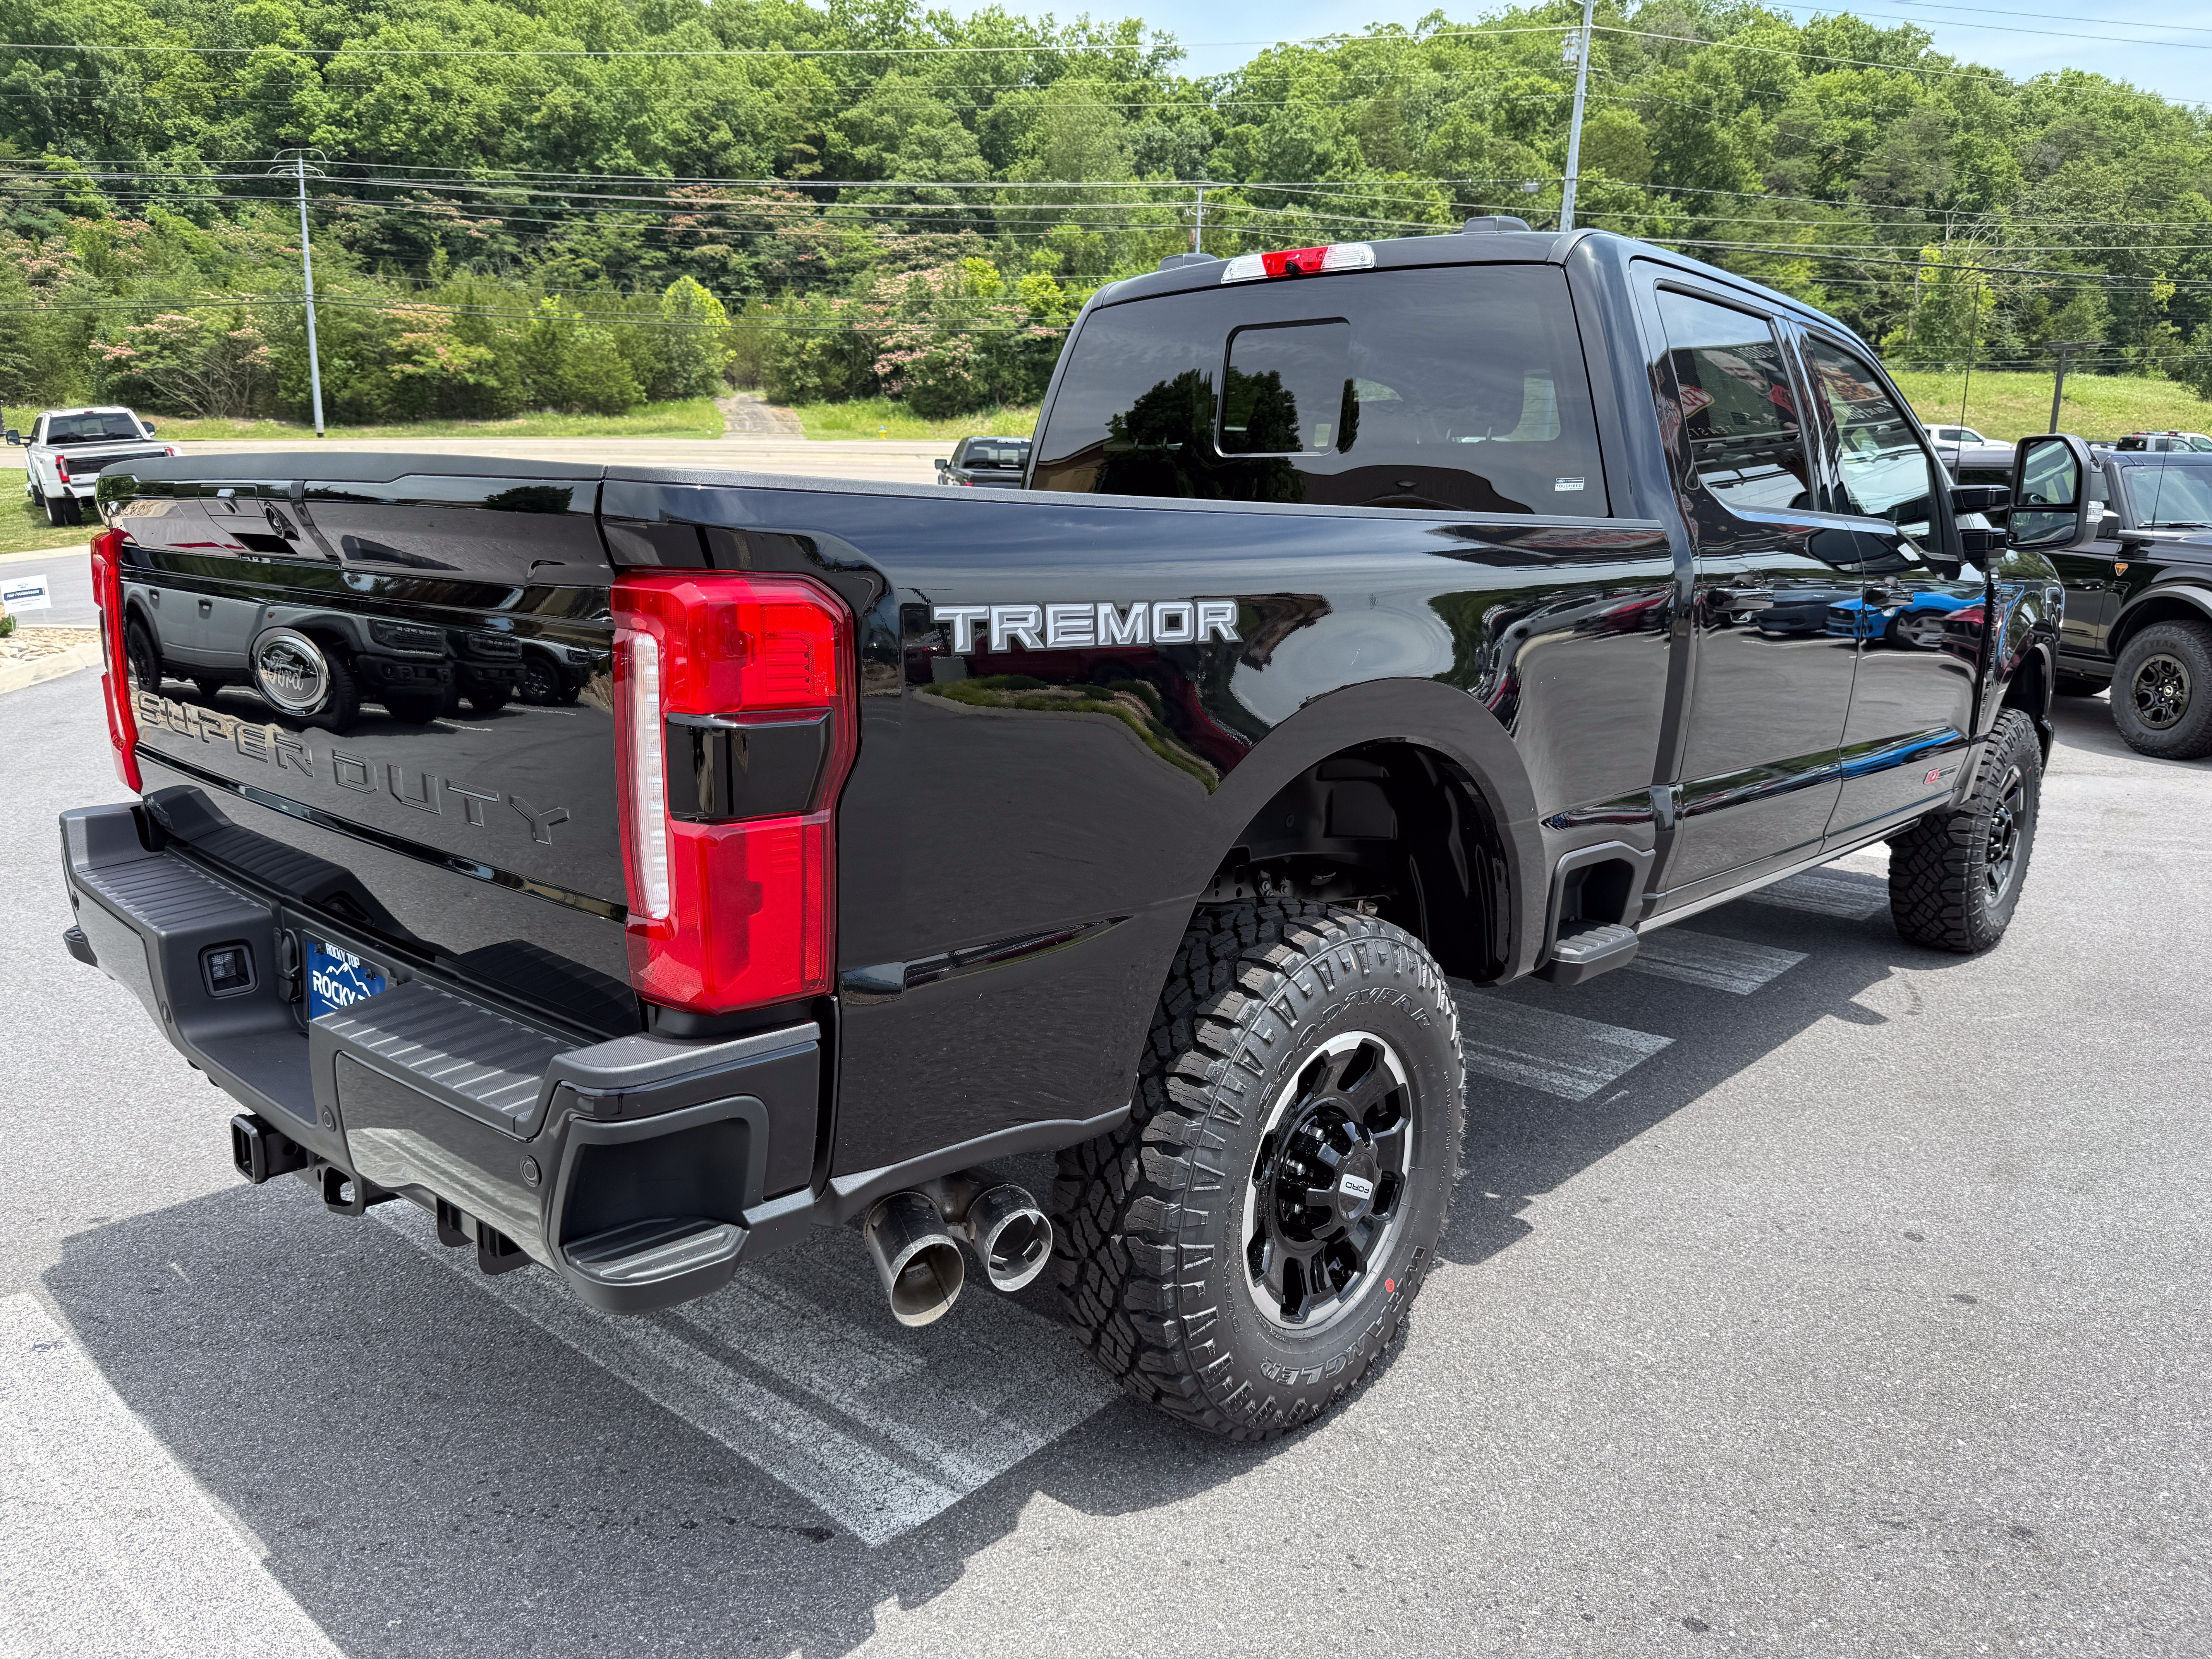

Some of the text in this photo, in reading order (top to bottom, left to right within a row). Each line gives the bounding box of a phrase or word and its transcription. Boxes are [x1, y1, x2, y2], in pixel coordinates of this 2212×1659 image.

[931, 599, 1242, 654] TREMOR
[263, 650, 304, 691] Ford
[137, 690, 570, 845] SUPER DUTY
[325, 943, 360, 969] ROCKY TOP
[313, 970, 356, 1006] ROCKY
[1257, 988, 1431, 1122] GOODYEAR
[1345, 1182, 1369, 1194] FORD
[1261, 1246, 1426, 1386] WRANGLER
